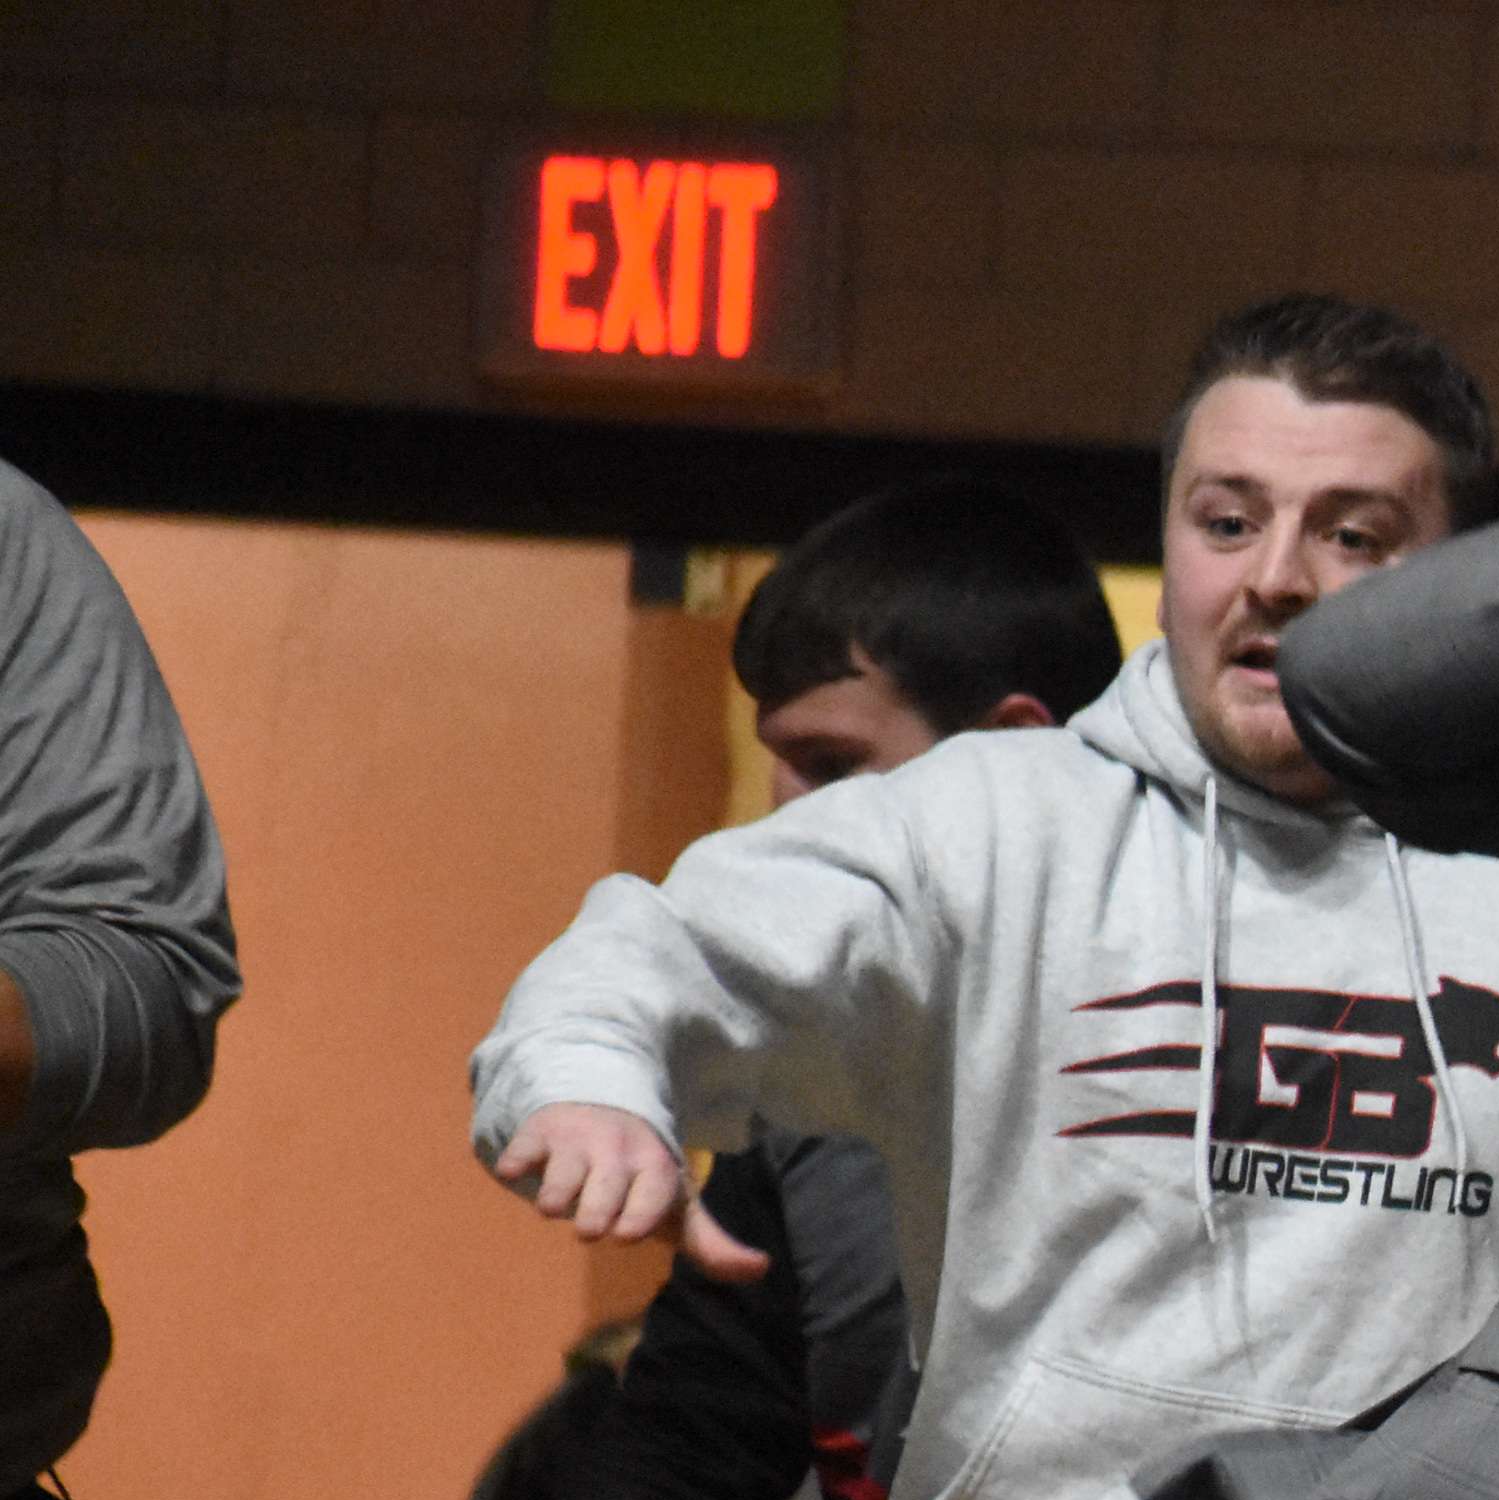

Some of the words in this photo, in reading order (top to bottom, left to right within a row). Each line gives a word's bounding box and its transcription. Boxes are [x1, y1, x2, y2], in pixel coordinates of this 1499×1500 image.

[534, 155, 779, 360] EXIT
[1211, 984, 1438, 1160] GB
[1208, 1144, 1495, 1218] WRESTLING
